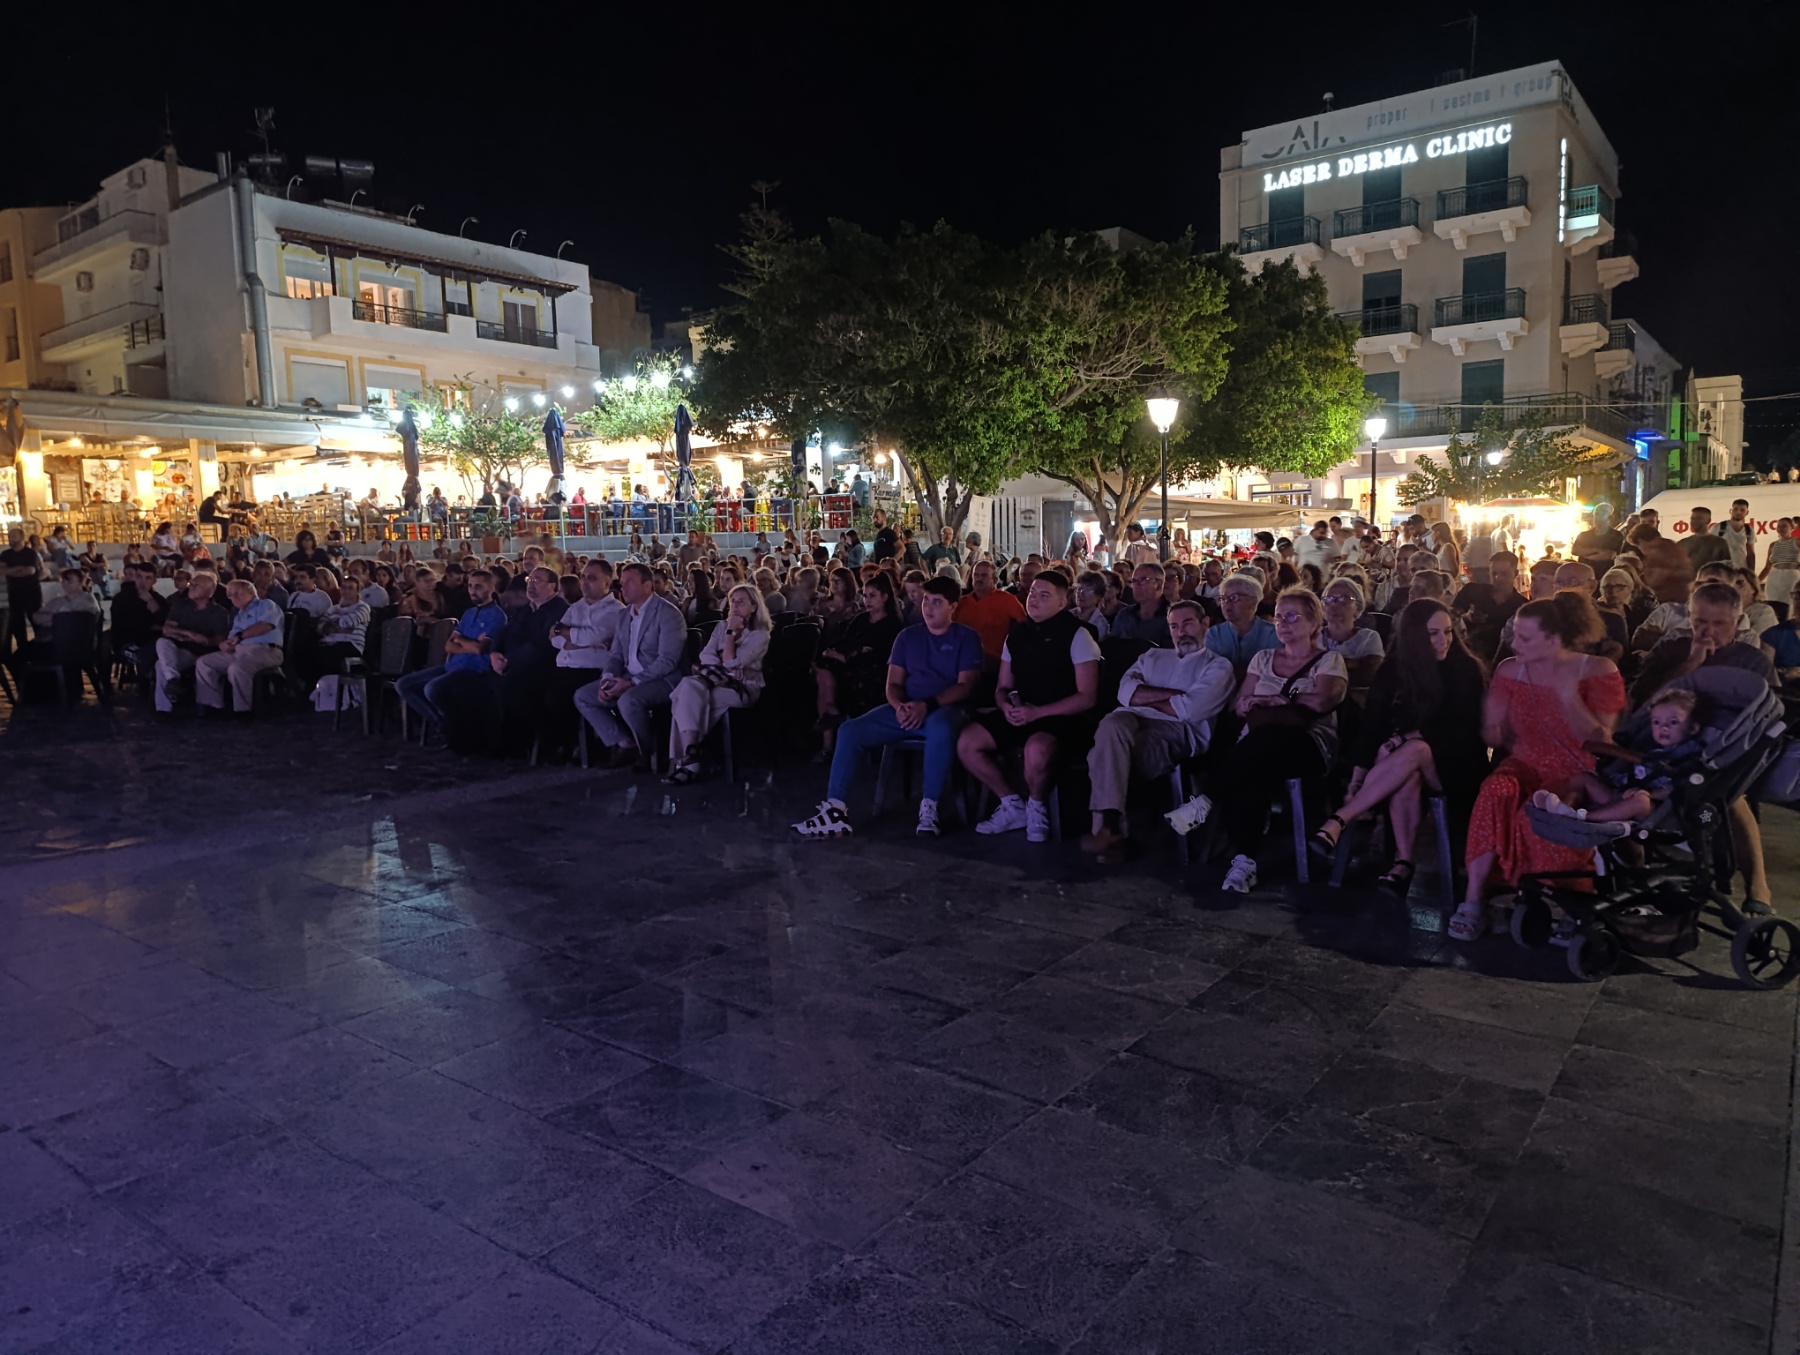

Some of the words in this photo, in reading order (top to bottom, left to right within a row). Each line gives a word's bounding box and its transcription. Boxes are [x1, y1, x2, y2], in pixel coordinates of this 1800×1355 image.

[1513, 75, 1552, 97] group
[1263, 162, 1332, 192] LASER
[1337, 143, 1418, 178] DERMA
[1426, 123, 1512, 159] CLINIC
[805, 807, 849, 829] AIR
